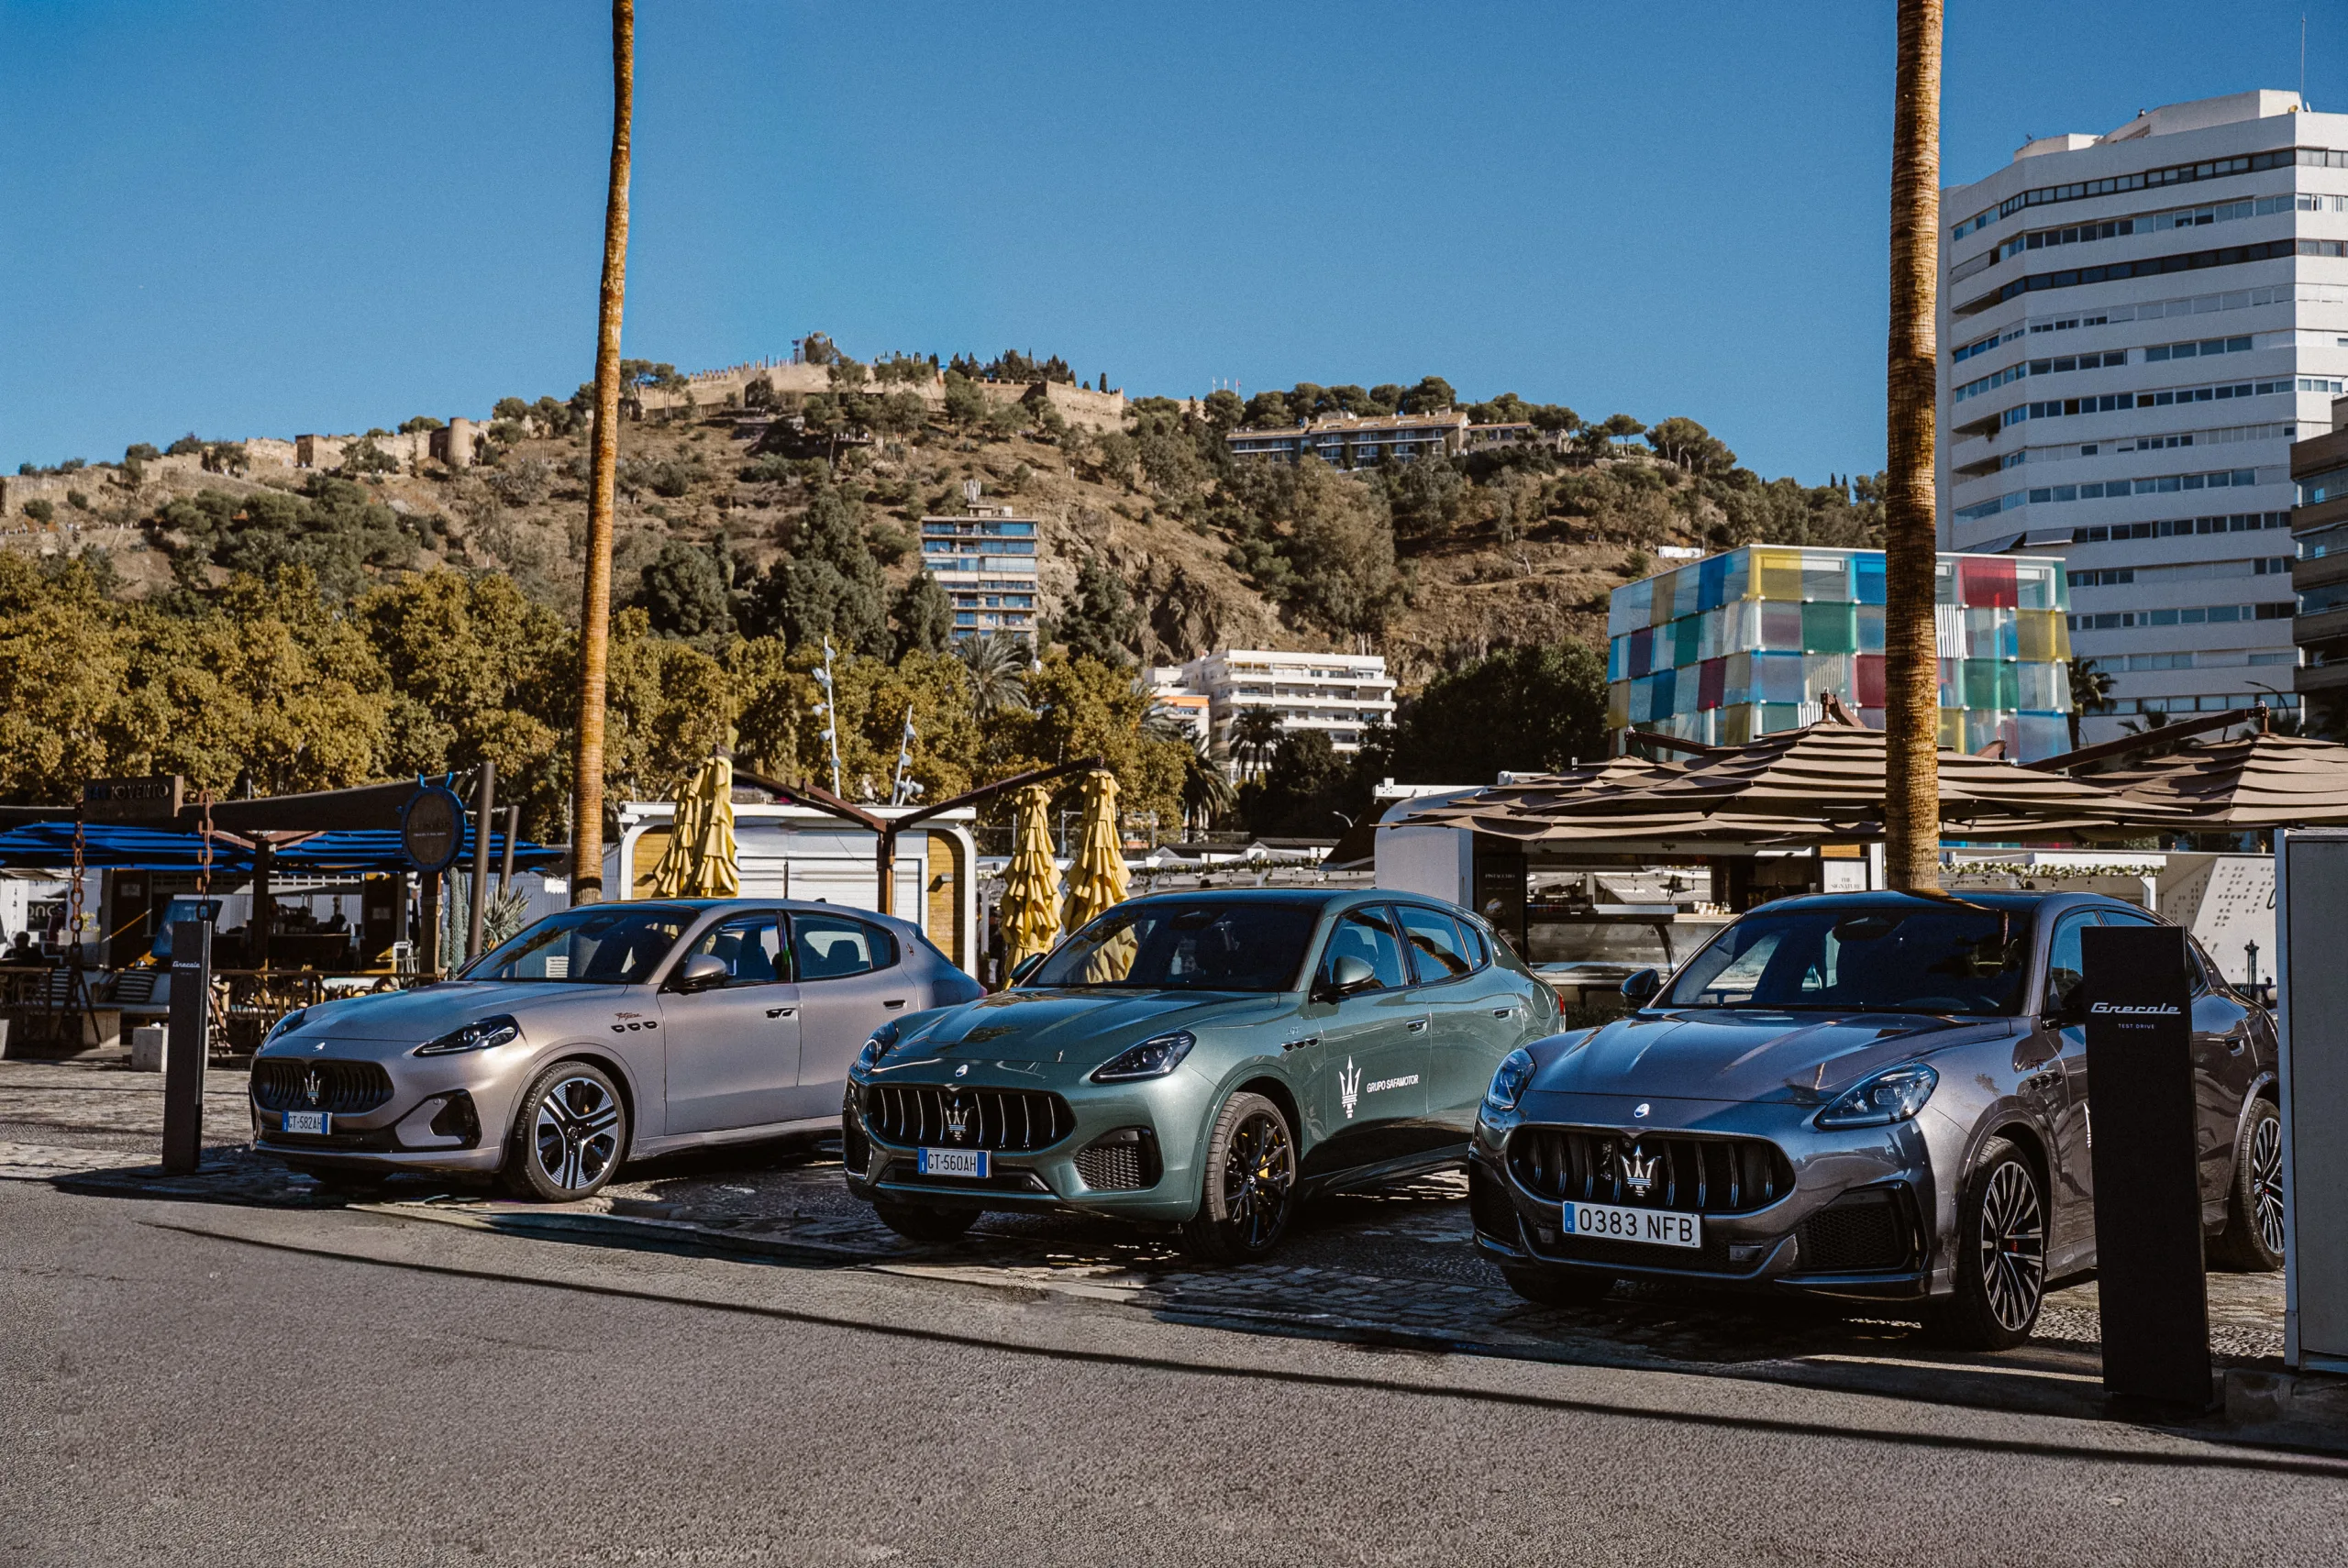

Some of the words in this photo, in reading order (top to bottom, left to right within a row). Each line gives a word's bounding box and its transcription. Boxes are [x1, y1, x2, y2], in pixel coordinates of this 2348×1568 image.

[2090, 1002, 2181, 1014] Grecale
[1367, 1080, 1386, 1093] GRUPO
[1386, 1074, 1419, 1089] SAFAMOTOR
[1579, 1208, 1637, 1237] 0383
[1646, 1214, 1693, 1242] NFB
